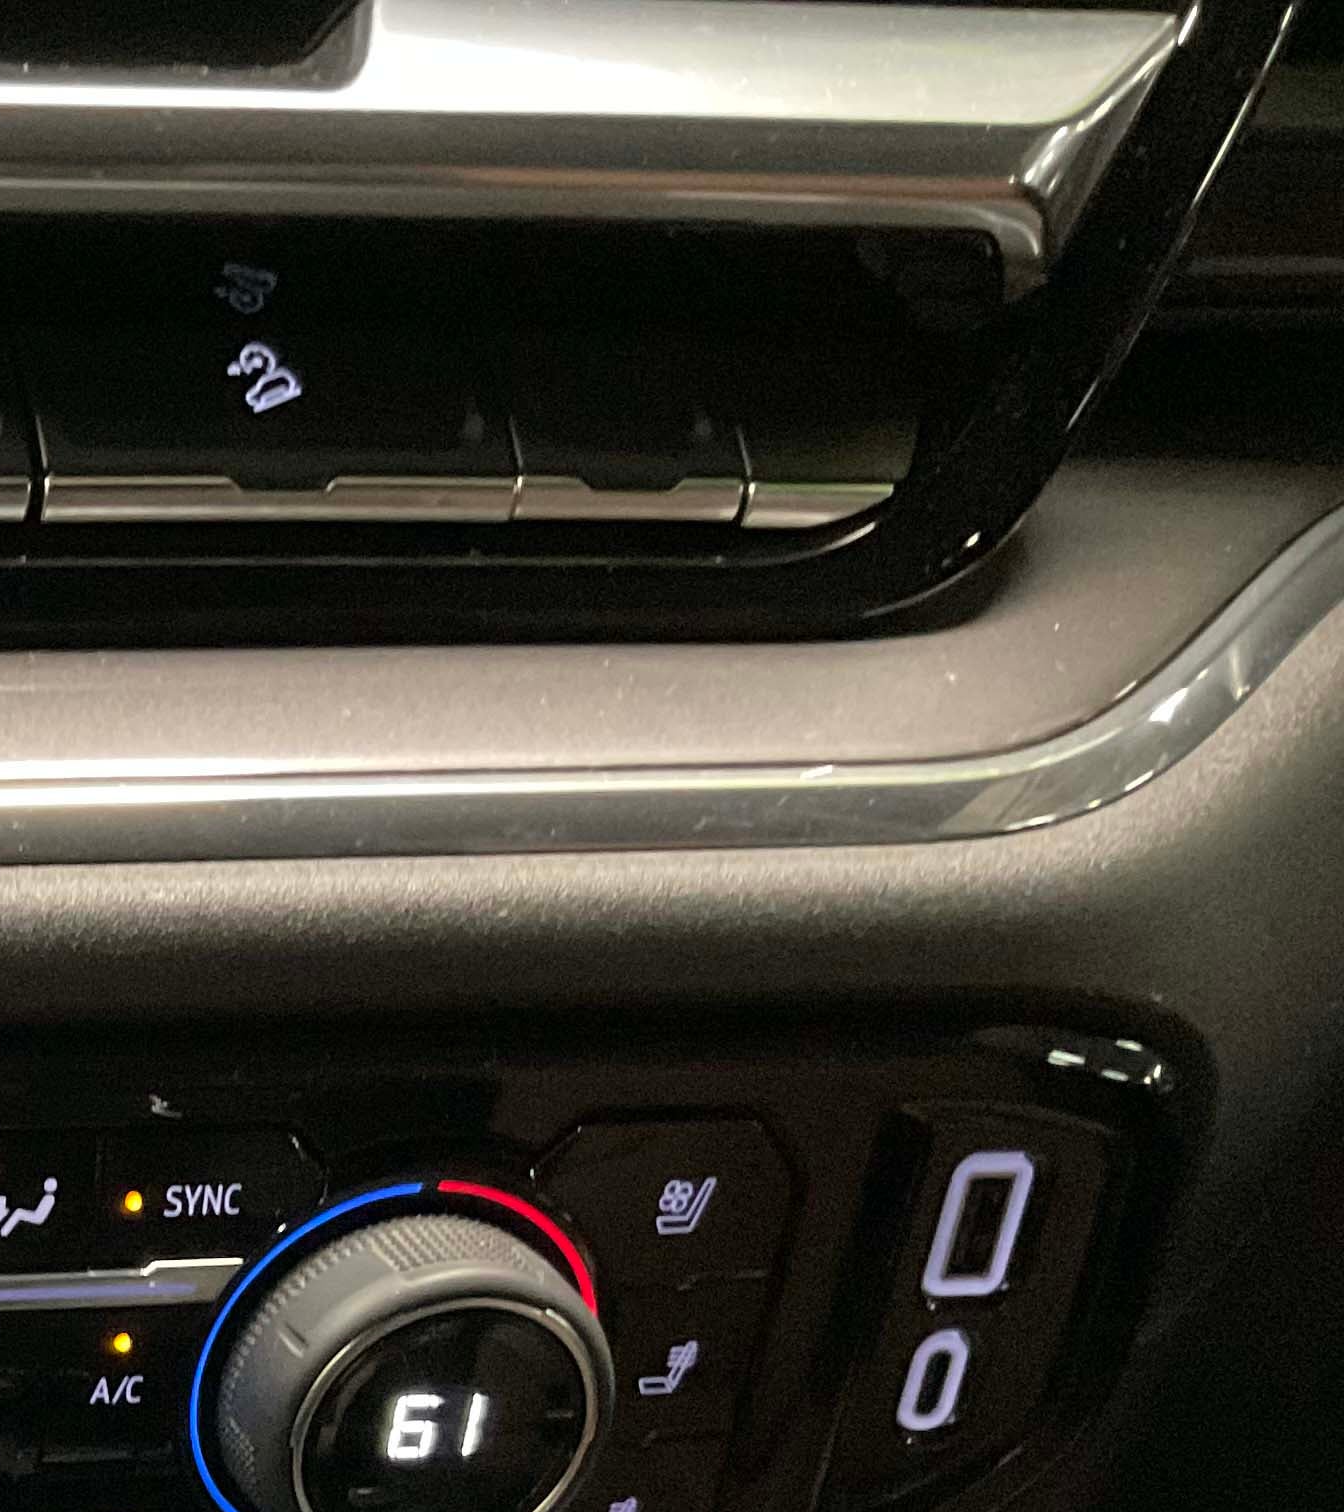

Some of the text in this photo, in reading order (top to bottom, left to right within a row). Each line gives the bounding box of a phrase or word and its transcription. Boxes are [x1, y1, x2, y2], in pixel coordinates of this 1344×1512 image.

[162, 1182, 243, 1218] SYNC
[88, 1374, 145, 1406] A/C
[384, 1390, 489, 1462] 61
